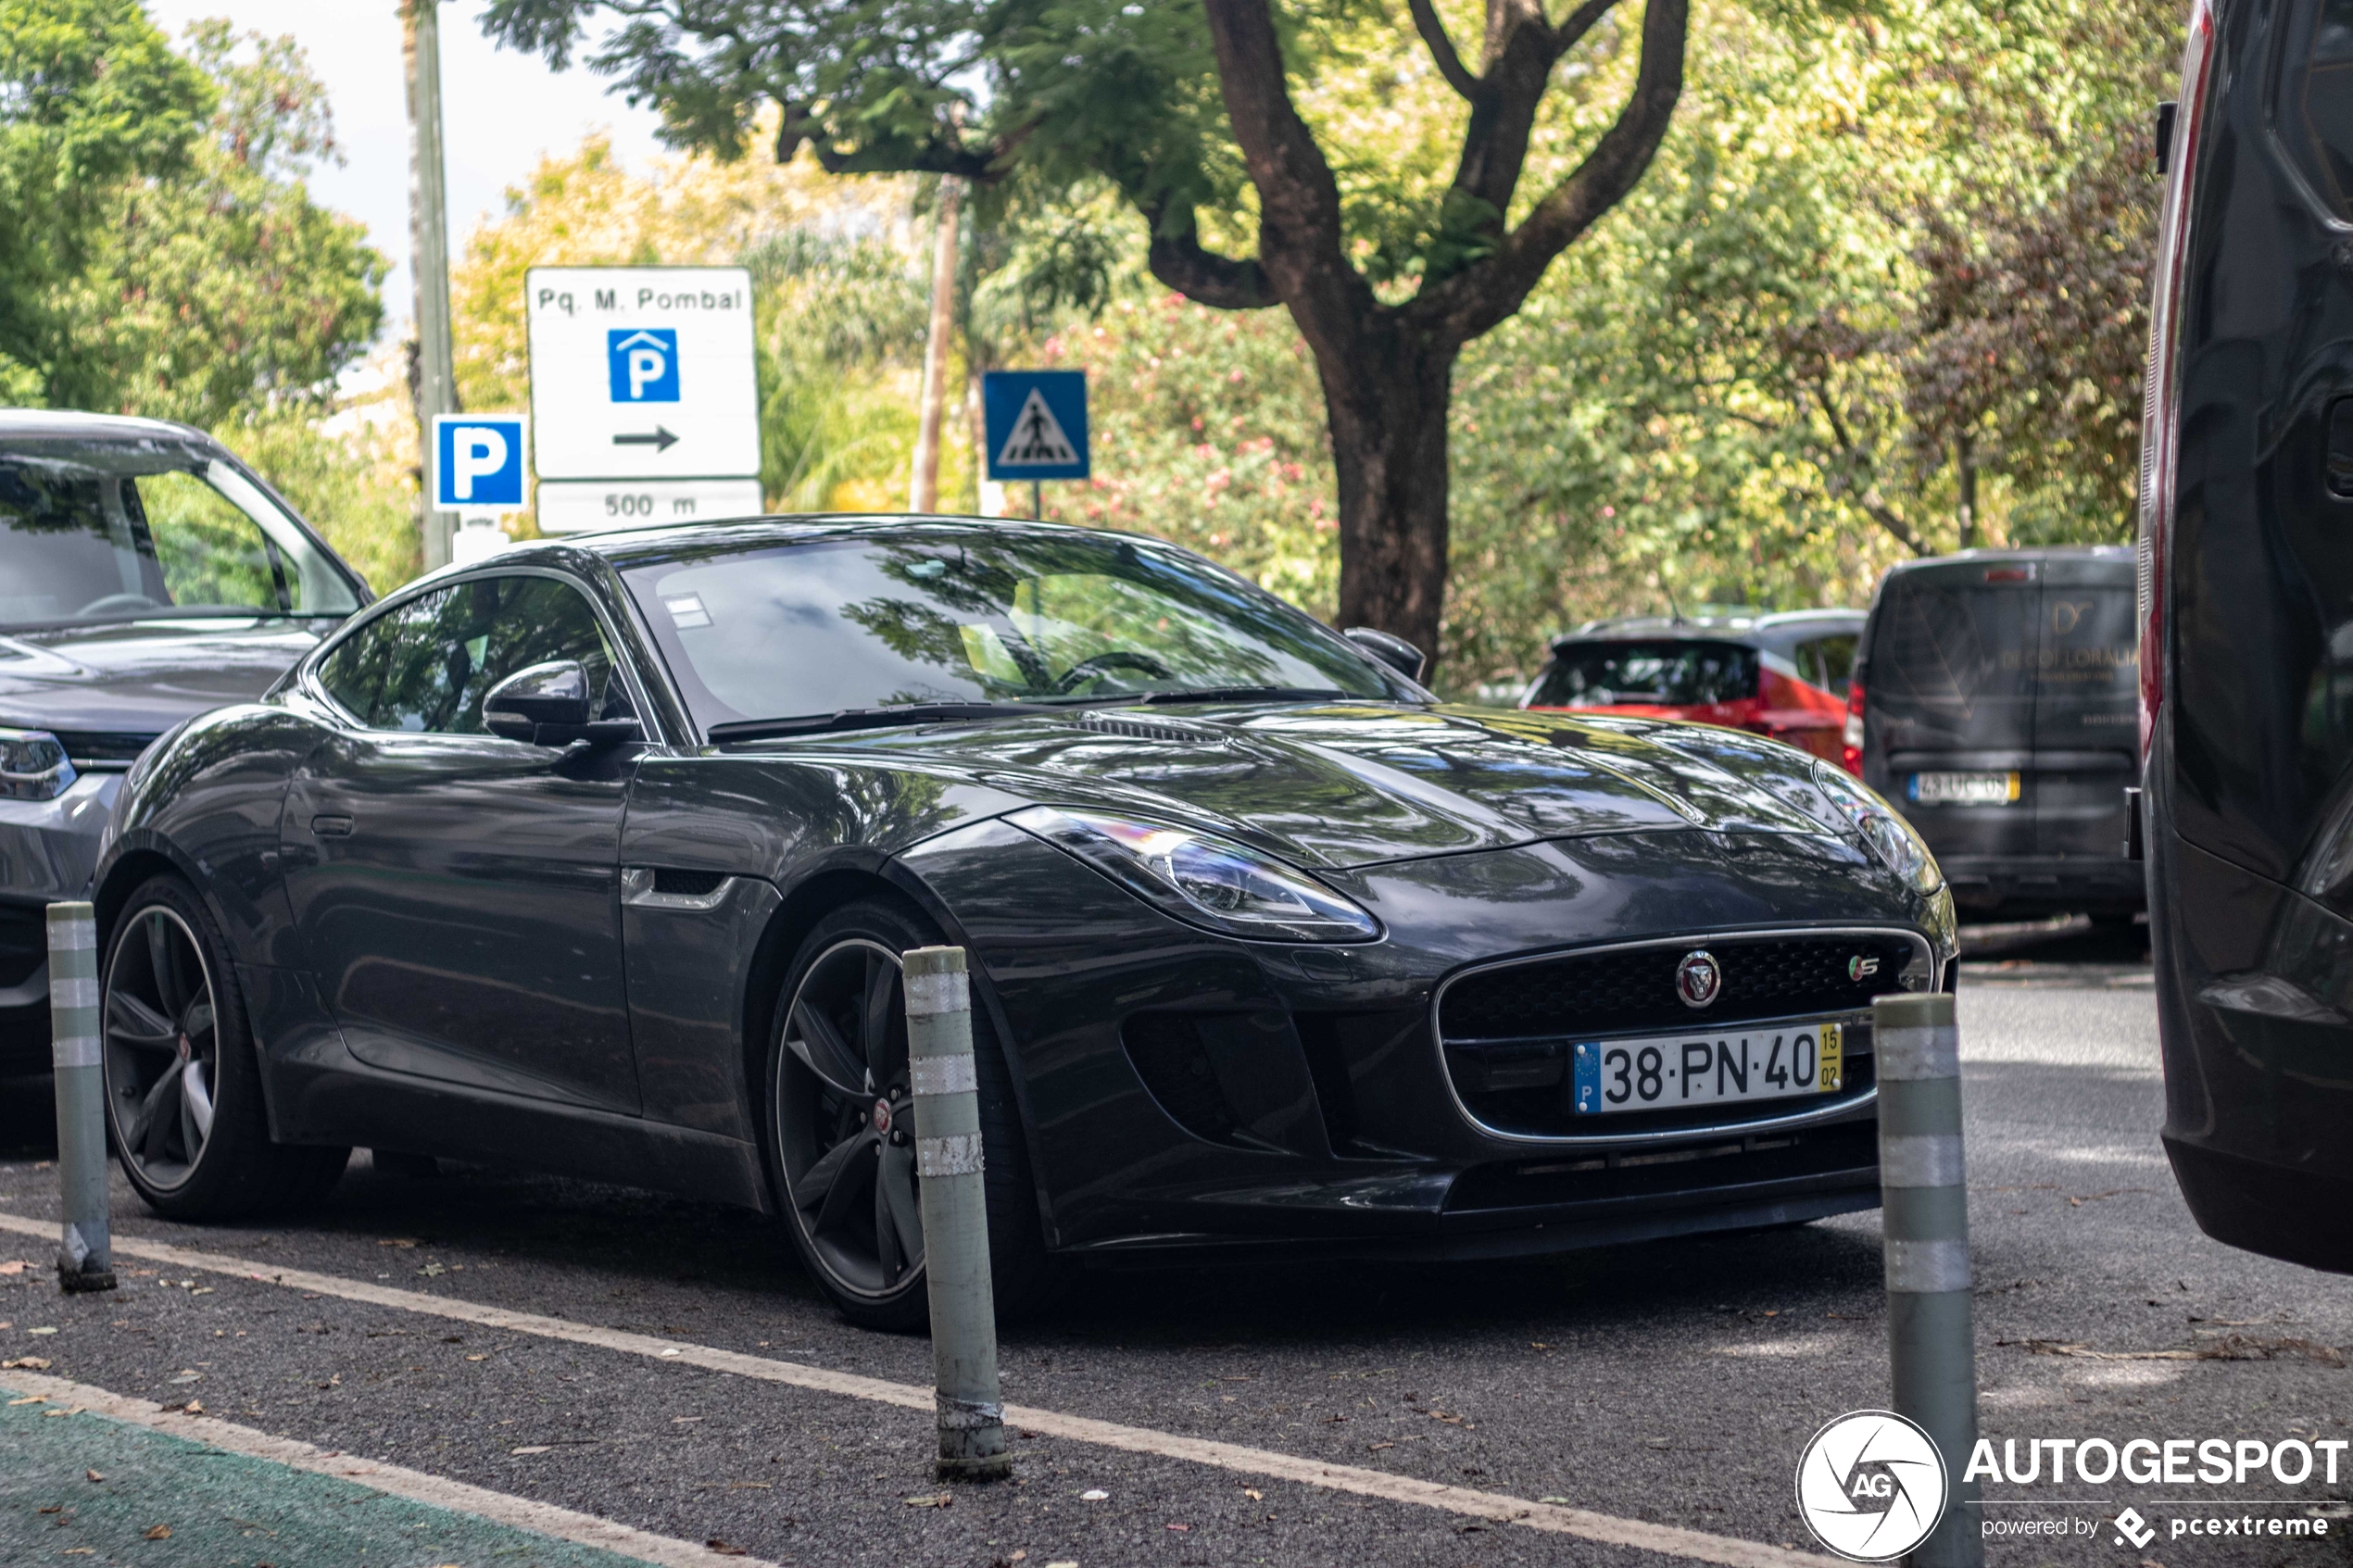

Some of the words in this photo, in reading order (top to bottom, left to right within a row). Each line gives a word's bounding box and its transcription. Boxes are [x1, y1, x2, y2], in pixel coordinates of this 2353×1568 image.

[538, 288, 582, 318] Pq.
[595, 288, 626, 310] M.
[637, 288, 742, 310] Pombal
[629, 349, 666, 399] P
[454, 427, 508, 499] P
[605, 493, 654, 517] 500
[673, 497, 696, 515] m
[1822, 1031, 1837, 1050] 15
[1821, 1066, 1838, 1086] 02
[1581, 1085, 1592, 1100] P
